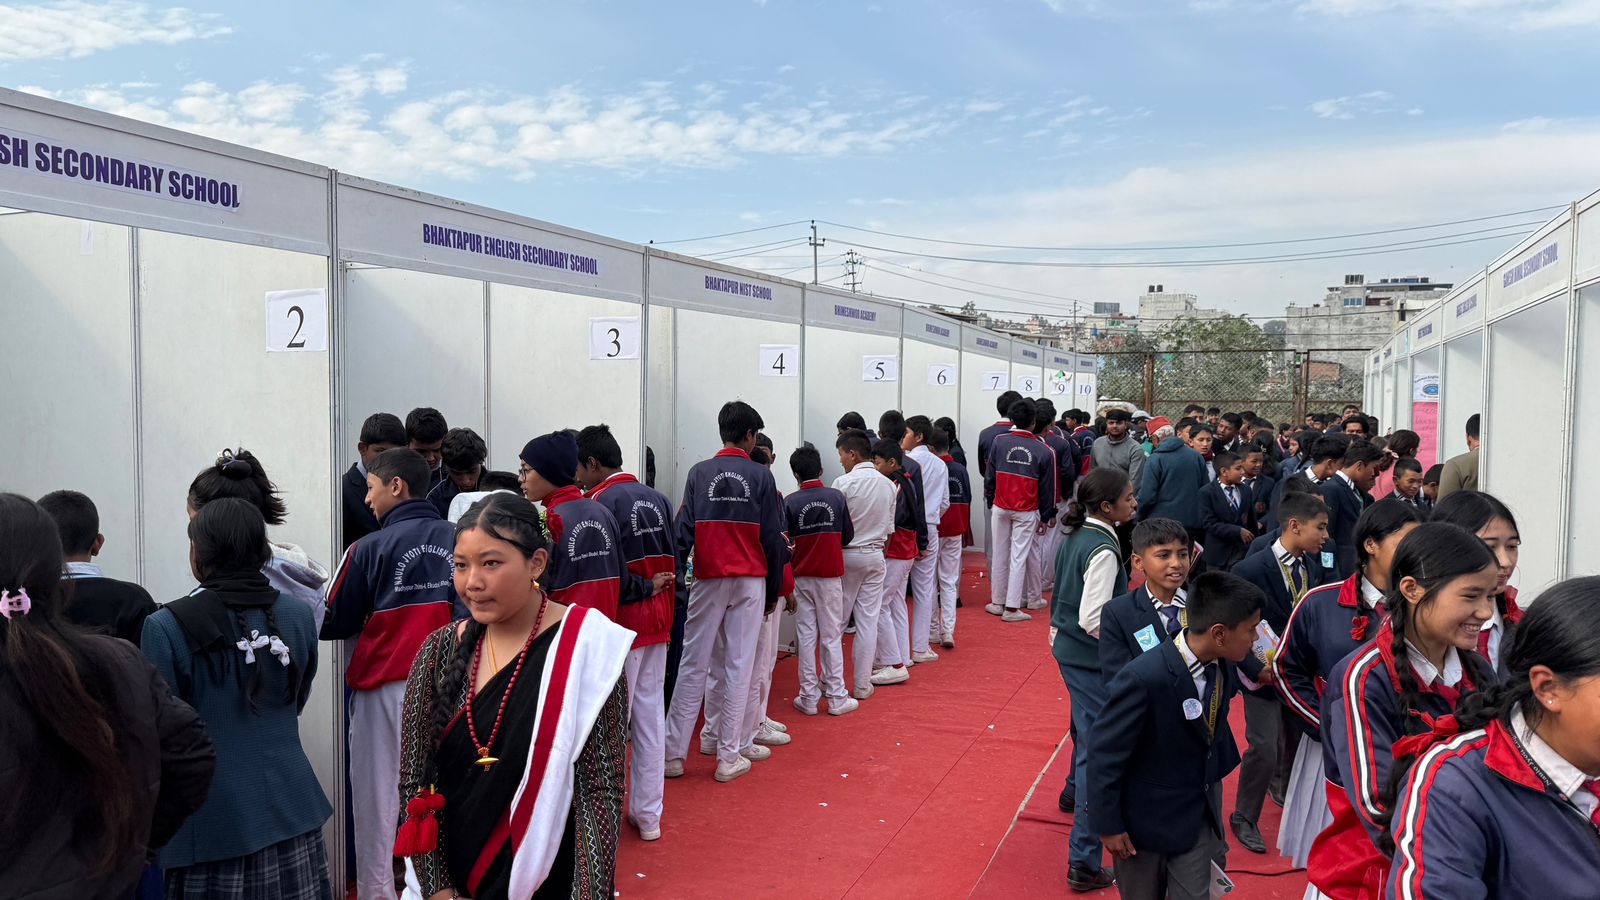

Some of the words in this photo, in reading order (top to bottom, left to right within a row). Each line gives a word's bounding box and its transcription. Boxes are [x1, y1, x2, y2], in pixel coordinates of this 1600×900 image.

[35, 142, 164, 194] SECONDARY
[168, 170, 240, 208] SCHOOL
[423, 223, 482, 254] BHAKTAPUR
[484, 236, 521, 260] ENGLISH
[522, 244, 569, 270] SECONDARY
[569, 253, 598, 275] SCHOOL
[704, 275, 739, 295] BHAKTAPUR
[752, 285, 772, 301] SCHOOL
[286, 305, 306, 349] 2
[606, 327, 621, 358] 3
[772, 352, 786, 375] 4
[874, 361, 886, 381] 5
[936, 368, 947, 386] 6
[990, 375, 999, 391] 7
[1025, 379, 1033, 392] 8
[1058, 383, 1066, 394] 9
[1079, 383, 1092, 395] 10
[601, 527, 612, 550] SCHOOL
[394, 561, 406, 586] NAULO
[402, 547, 422, 563] JYOTI
